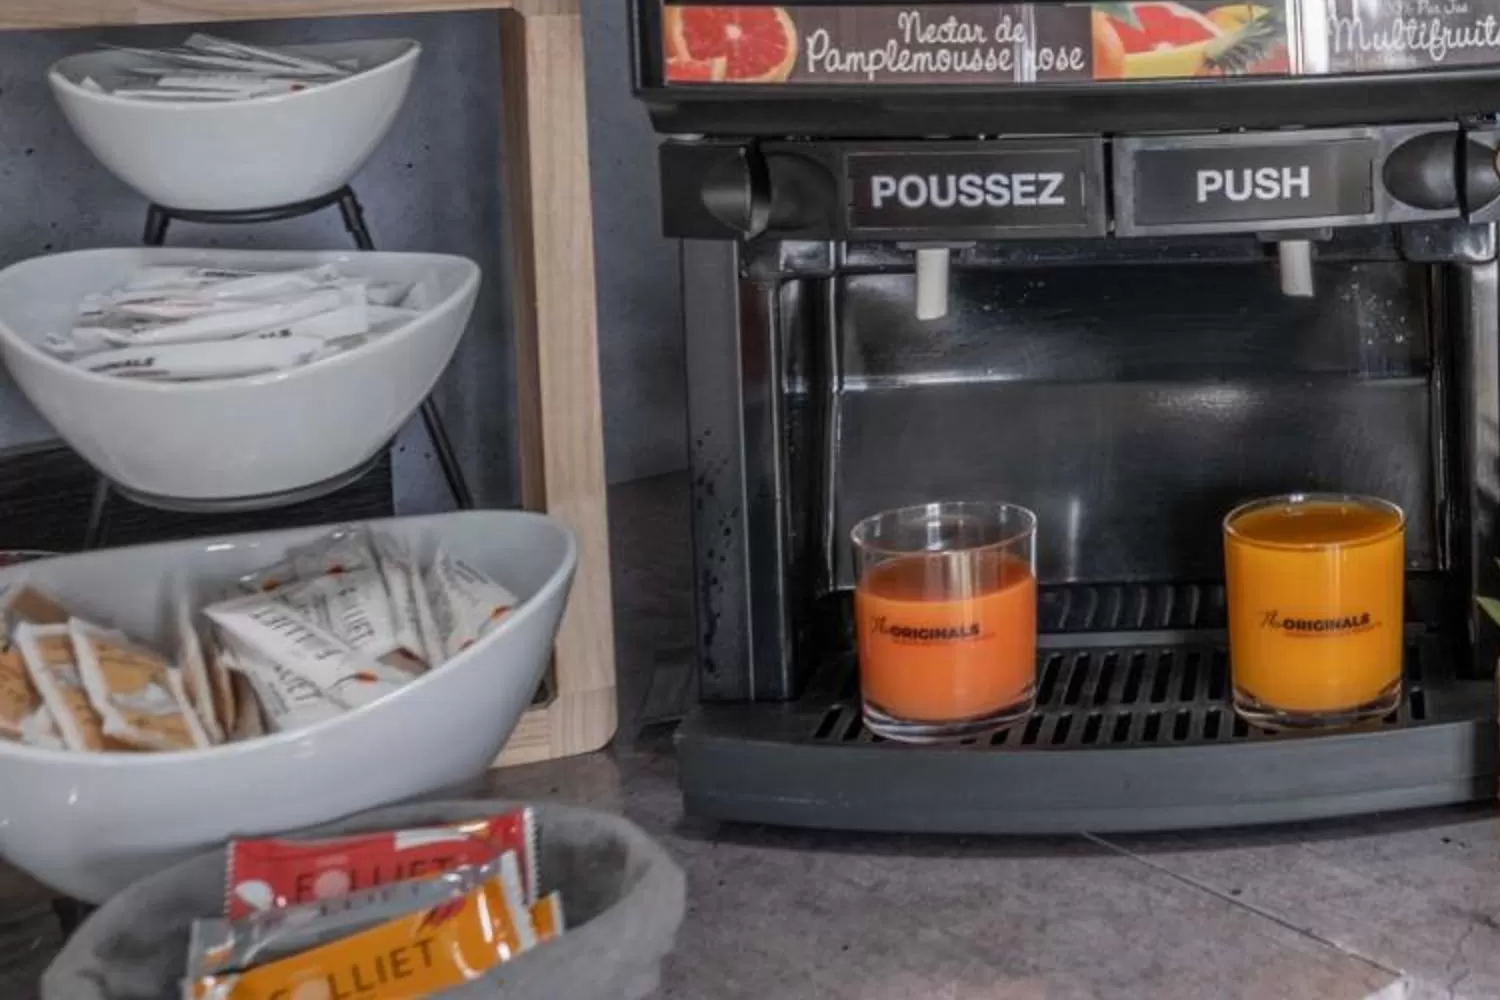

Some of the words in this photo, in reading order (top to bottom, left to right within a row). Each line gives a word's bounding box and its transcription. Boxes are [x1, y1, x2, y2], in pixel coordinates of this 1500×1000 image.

[898, 10, 988, 44] Nectar
[995, 14, 1026, 44] de
[806, 28, 1013, 82] Pamplemousse
[871, 171, 1066, 209] POUSSEZ
[1197, 165, 1311, 204] PUSH
[889, 622, 980, 641] ORIGINALS
[1282, 612, 1372, 633] ORIGINALS
